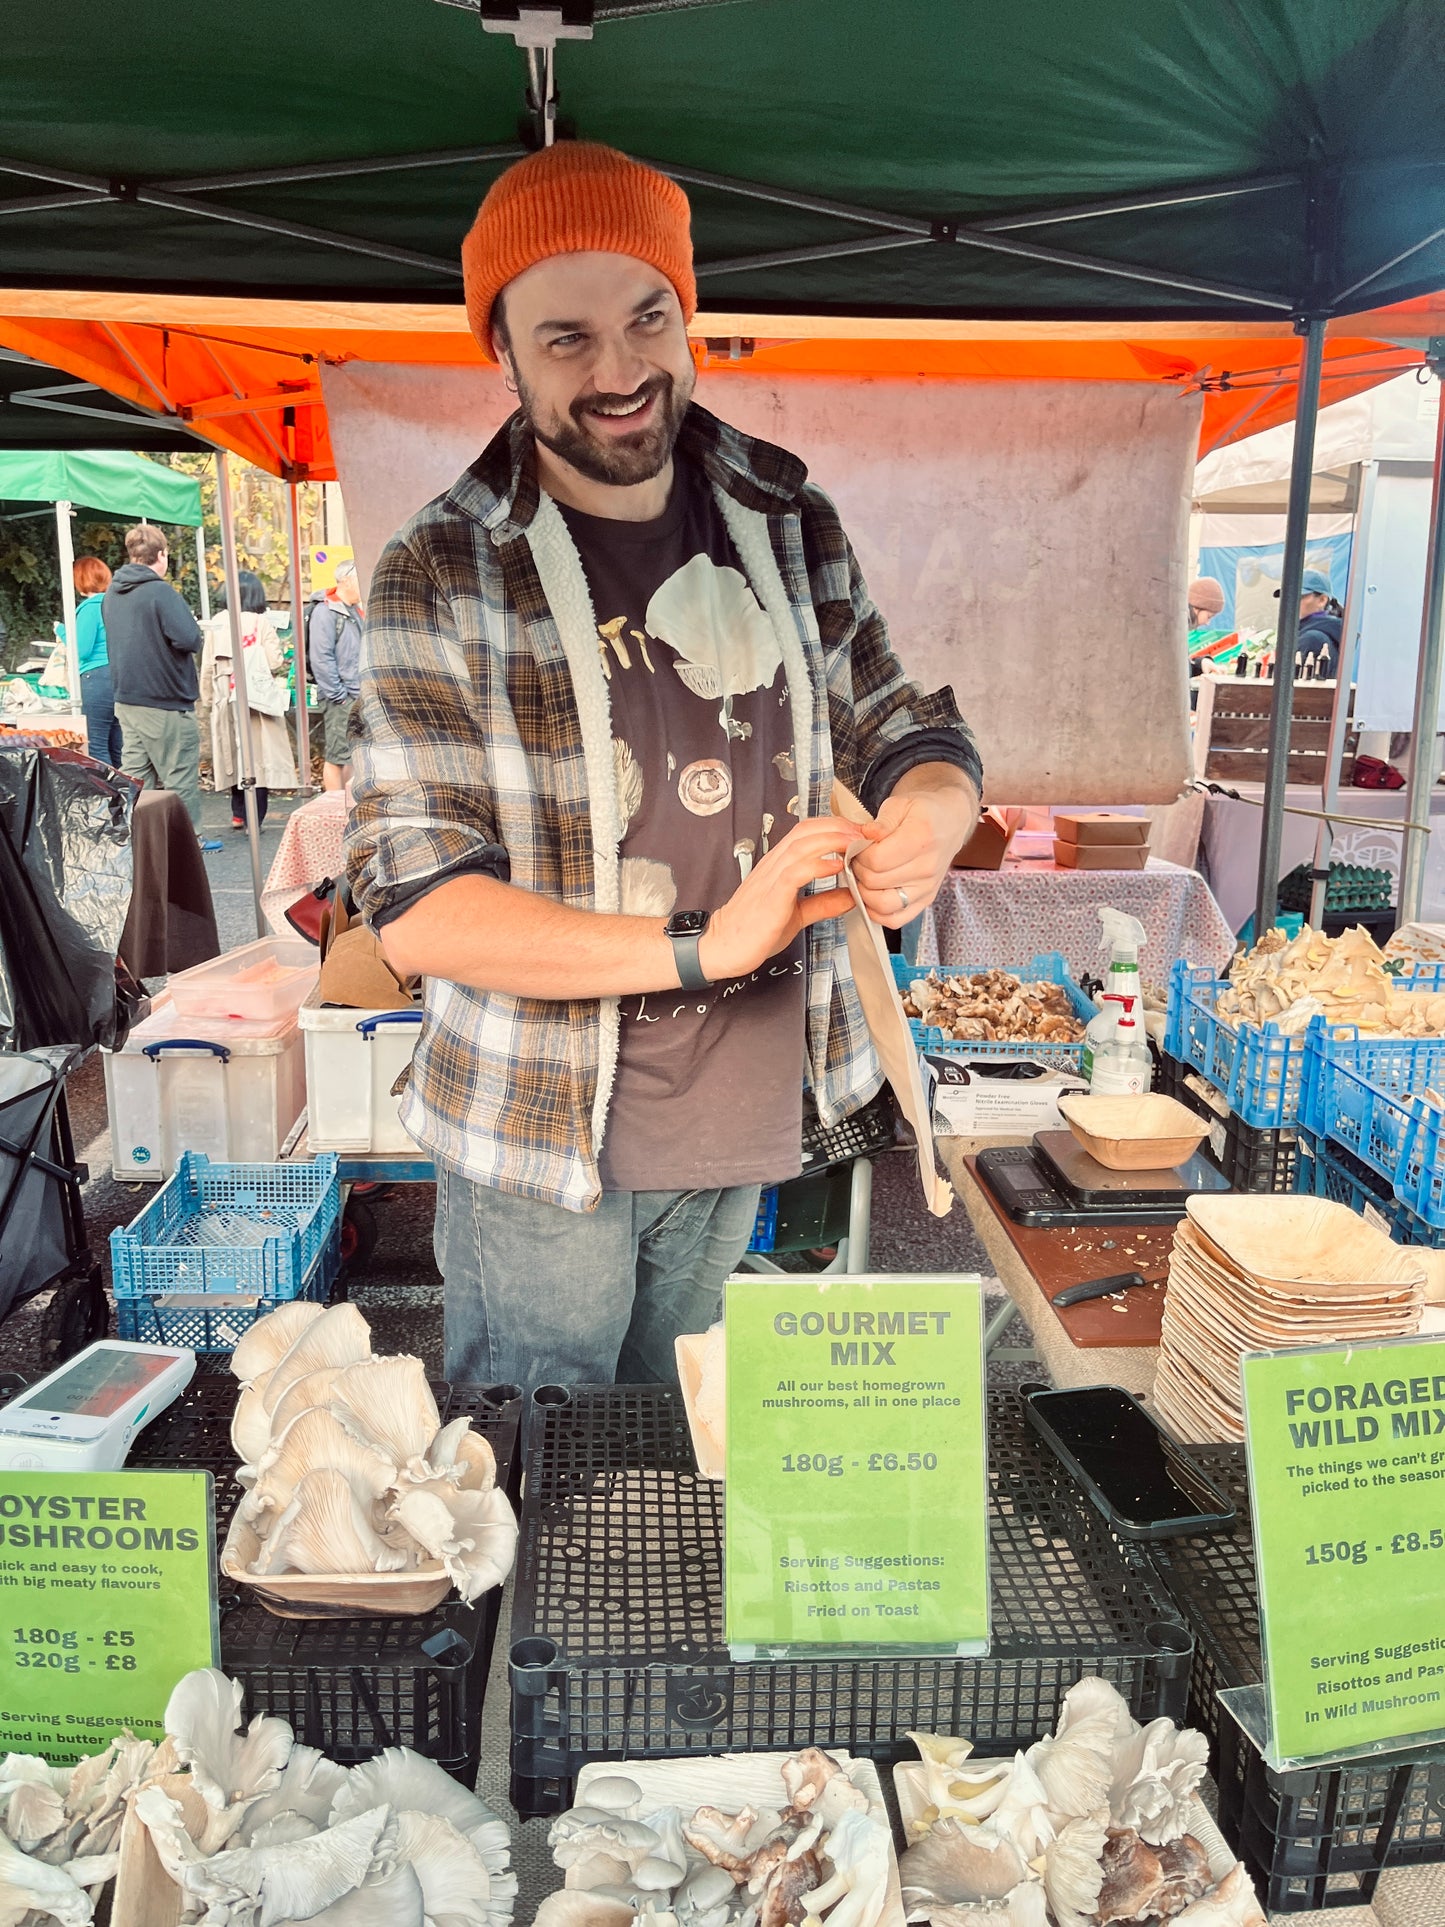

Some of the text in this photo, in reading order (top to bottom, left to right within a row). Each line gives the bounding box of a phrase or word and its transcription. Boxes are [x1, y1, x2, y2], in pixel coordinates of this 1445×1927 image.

[774, 1312, 950, 1335] GOURMET
[831, 1342, 896, 1365] MIX
[777, 1380, 945, 1393] All our best homegrown
[1286, 1376, 1445, 1416] FORAGED
[763, 1397, 848, 1409] mushrooms,
[853, 1396, 869, 1406] all
[875, 1396, 887, 1406] in
[923, 1396, 960, 1408] place
[1289, 1416, 1379, 1448] WILD
[782, 1454, 843, 1476] 180g
[868, 1453, 937, 1471] £6.50
[1286, 1465, 1313, 1477] The
[1319, 1461, 1362, 1474] things
[1367, 1459, 1387, 1468] we
[1392, 1452, 1426, 1466] can't
[1303, 1478, 1349, 1497] picked
[1354, 1477, 1368, 1488] to
[1372, 1474, 1395, 1486] the
[0, 1495, 146, 1520] OYSTER
[0, 1524, 198, 1551] SHROOMS
[1305, 1541, 1367, 1565] 150g
[1391, 1529, 1445, 1554] £8.5
[30, 1562, 56, 1571] and
[62, 1565, 96, 1575] easy
[101, 1564, 116, 1573] to
[122, 1564, 162, 1576] cook,
[780, 1555, 944, 1570] Serving Suggestions:
[24, 1576, 46, 1589] big
[51, 1578, 96, 1590] meaty
[101, 1578, 160, 1589] flavours
[785, 1579, 940, 1592] Risottos and Pastas
[808, 1604, 919, 1616] Fried on Toast
[14, 1628, 78, 1649] 180g
[103, 1631, 134, 1646] £5
[16, 1652, 80, 1673] 320g
[105, 1655, 136, 1670] £8
[1311, 1650, 1369, 1669] Serving
[1317, 1666, 1445, 1694] Risottos and Pas
[1306, 1691, 1440, 1723] In Wild Mushroom
[1, 1712, 60, 1725] Serving
[37, 1732, 51, 1742] in
[57, 1734, 105, 1745] butter
